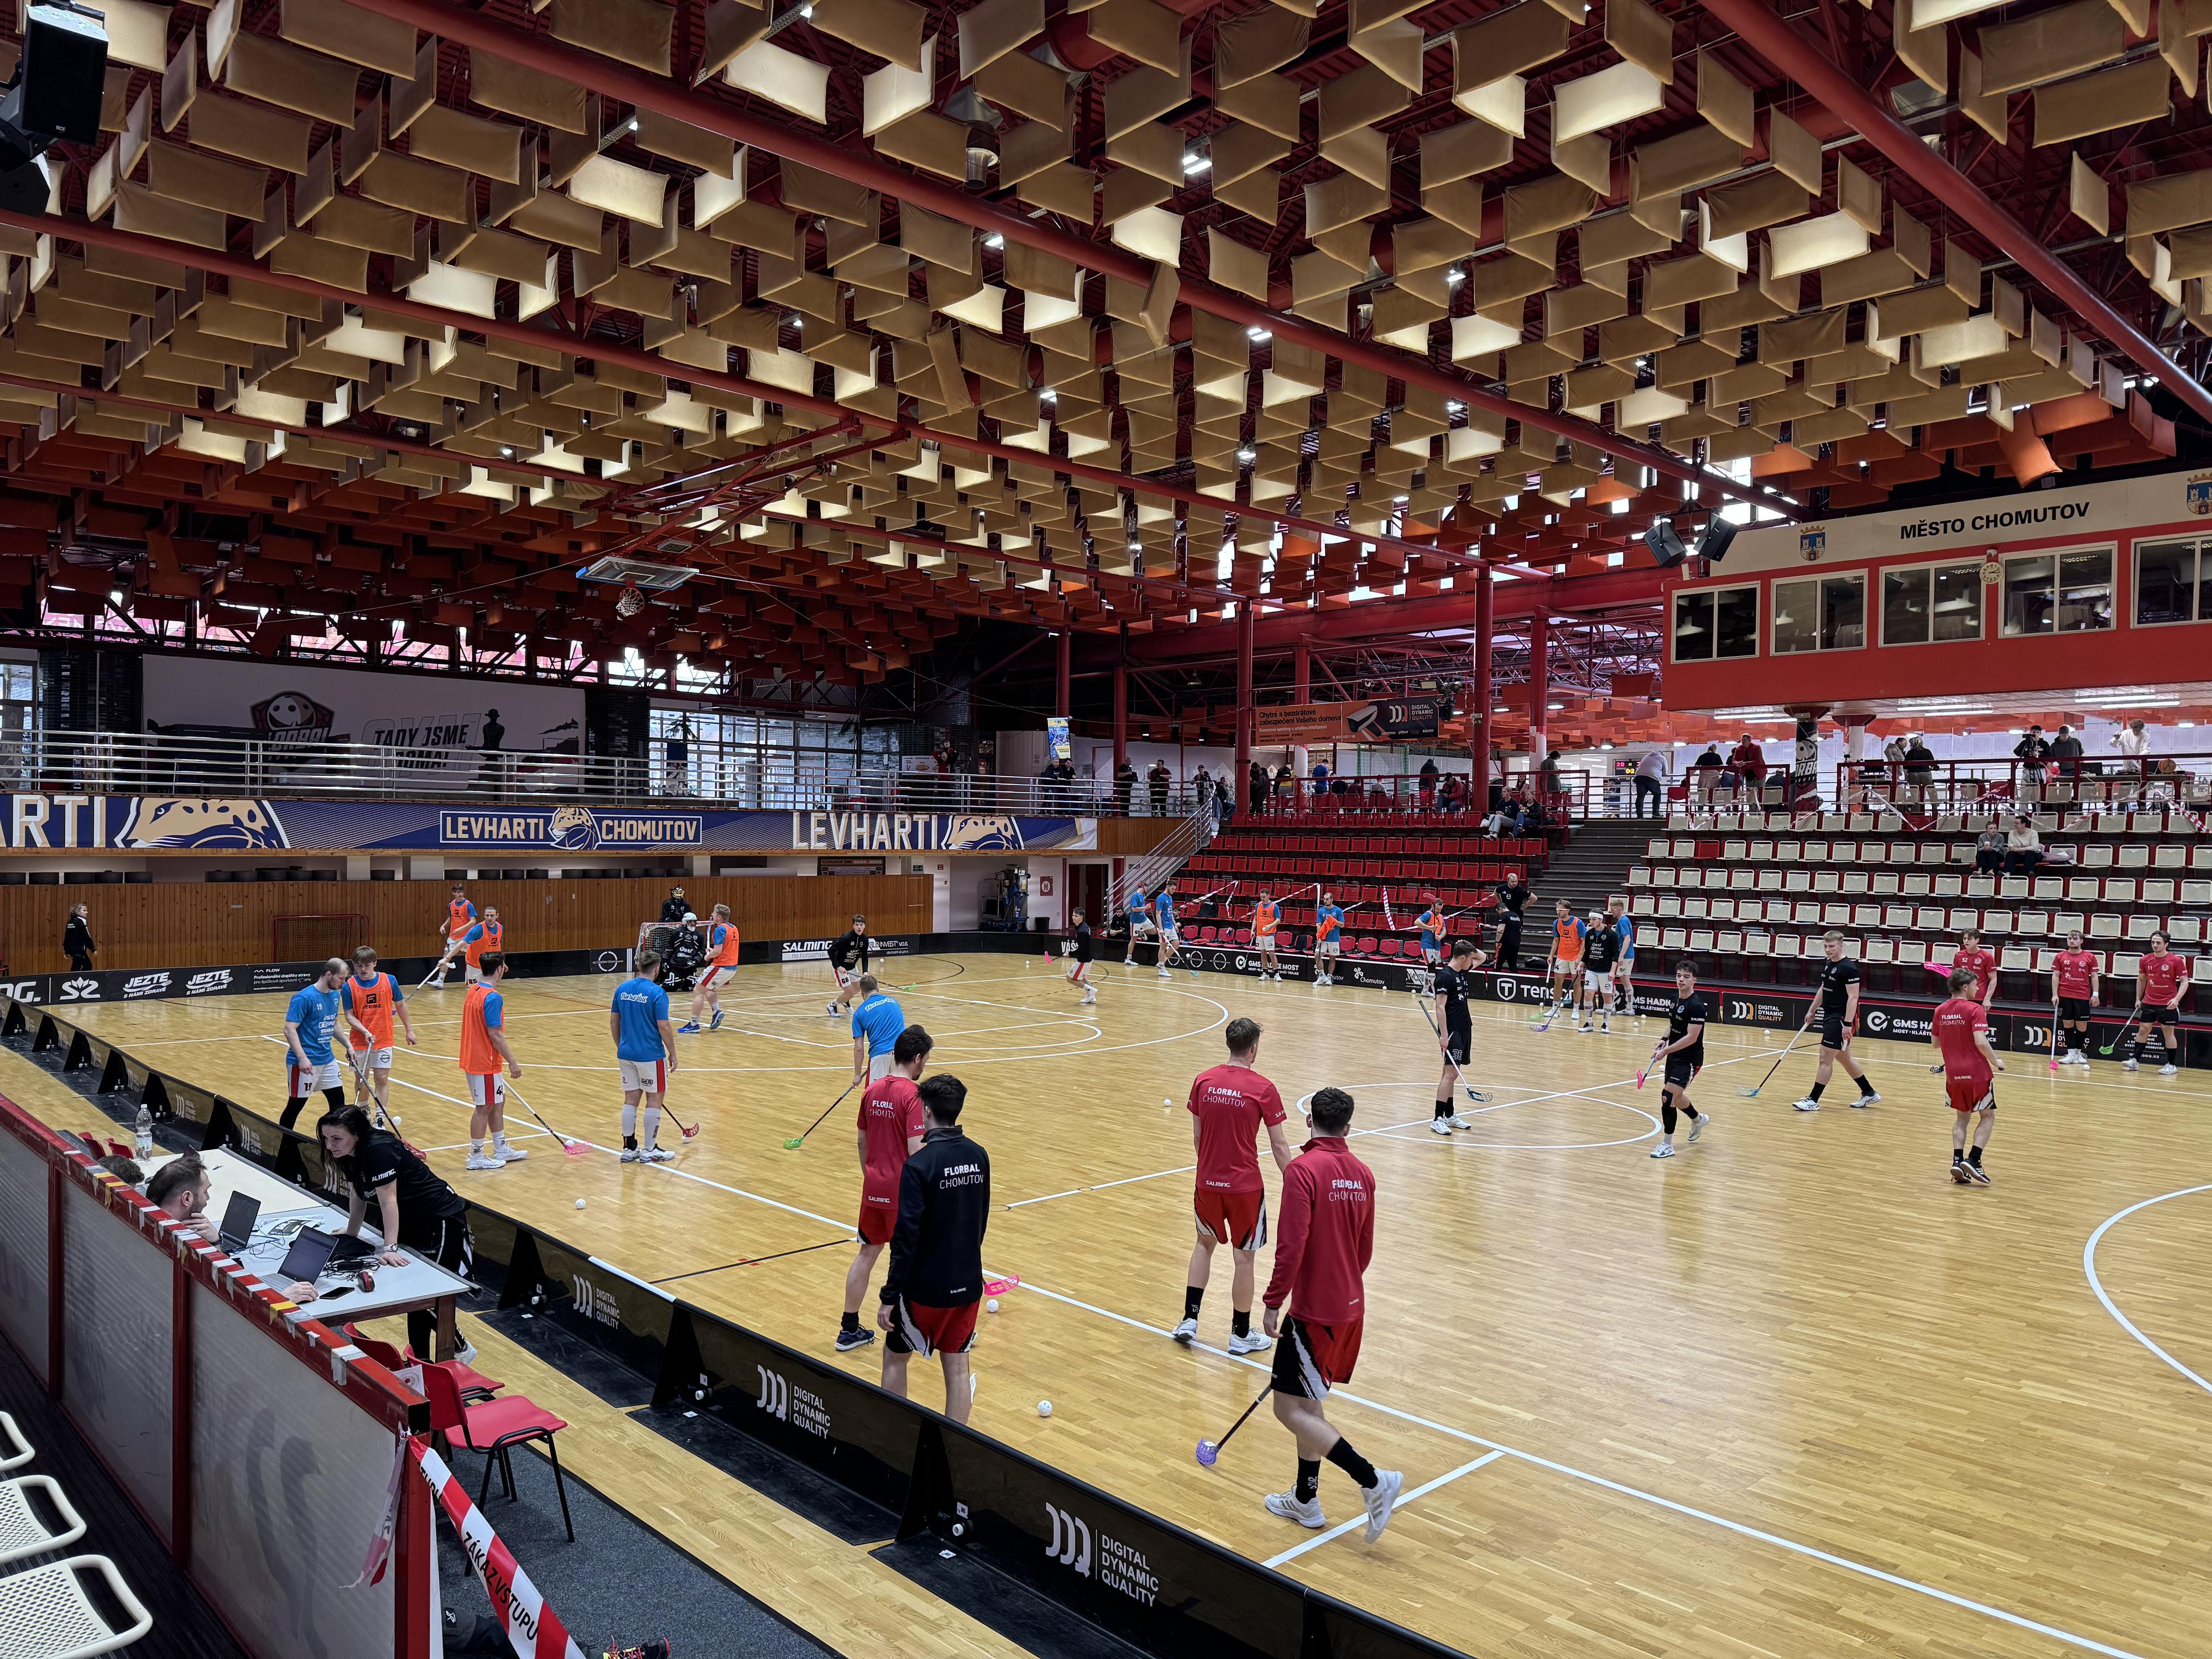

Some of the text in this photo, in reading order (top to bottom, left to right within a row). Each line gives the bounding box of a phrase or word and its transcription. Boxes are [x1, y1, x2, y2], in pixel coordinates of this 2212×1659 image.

[1901, 502, 2090, 539] MĚSTO CHOMUTOV
[1259, 717, 1295, 726] zabezpečení
[1284, 709, 1316, 717] bezdrátové
[374, 724, 469, 747] TADY JSME
[0, 794, 106, 848] RTI
[446, 816, 697, 841] LEVHARTI CHOMUTOV
[793, 812, 938, 849] LEVHARTI
[124, 972, 169, 988] JEZTE
[187, 969, 231, 984] JEZTE
[1360, 977, 1385, 985] Chomutov
[144, 987, 166, 995] ZDRAVĚ
[206, 983, 227, 992] ZDRAVĚ
[1893, 1019, 1918, 1029] GMS
[1203, 1095, 1246, 1107] CHOMUTOV
[1208, 1087, 1241, 1098] FLORBAL
[372, 1168, 396, 1182] ALMING.
[945, 1163, 980, 1176] FLORBAL
[940, 1174, 984, 1189] CHOMUTOV
[597, 1288, 616, 1306] DIGITAL
[597, 1299, 619, 1319] DYNAMIC
[597, 1311, 618, 1329] QUALITY
[794, 1385, 825, 1410] DIGITAL
[794, 1399, 831, 1426] DYNAMIC
[794, 1413, 828, 1439] QUALITY
[1102, 1534, 1150, 1571] DIGITAL
[1102, 1553, 1159, 1592] DYNAMIC
[463, 1531, 539, 1640] ZÁKAZ VSTUPU
[1102, 1569, 1156, 1607] QUALITY
